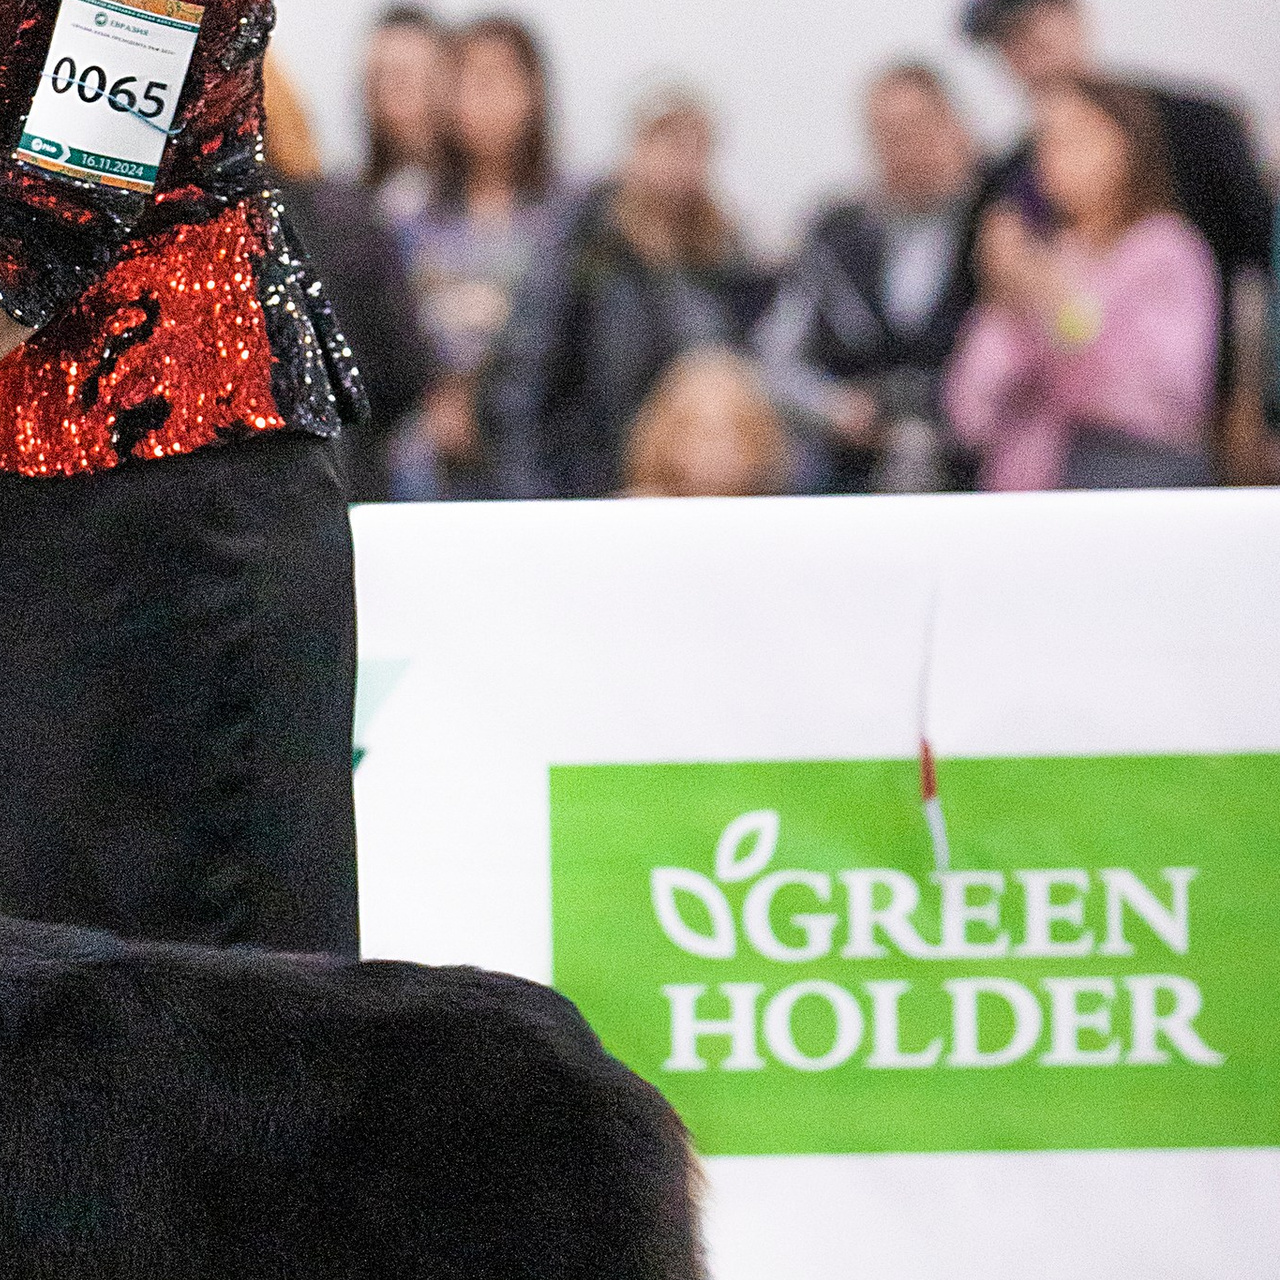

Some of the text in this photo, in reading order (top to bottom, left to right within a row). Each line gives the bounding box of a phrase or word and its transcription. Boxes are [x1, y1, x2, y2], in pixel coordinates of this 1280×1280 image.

[111, 20, 149, 36] ЕВРАЗИЯ
[52, 57, 167, 118] 0065
[82, 154, 144, 177] 16.11.2024
[742, 867, 1198, 962] GREEN
[661, 974, 1225, 1071] HOLDER
